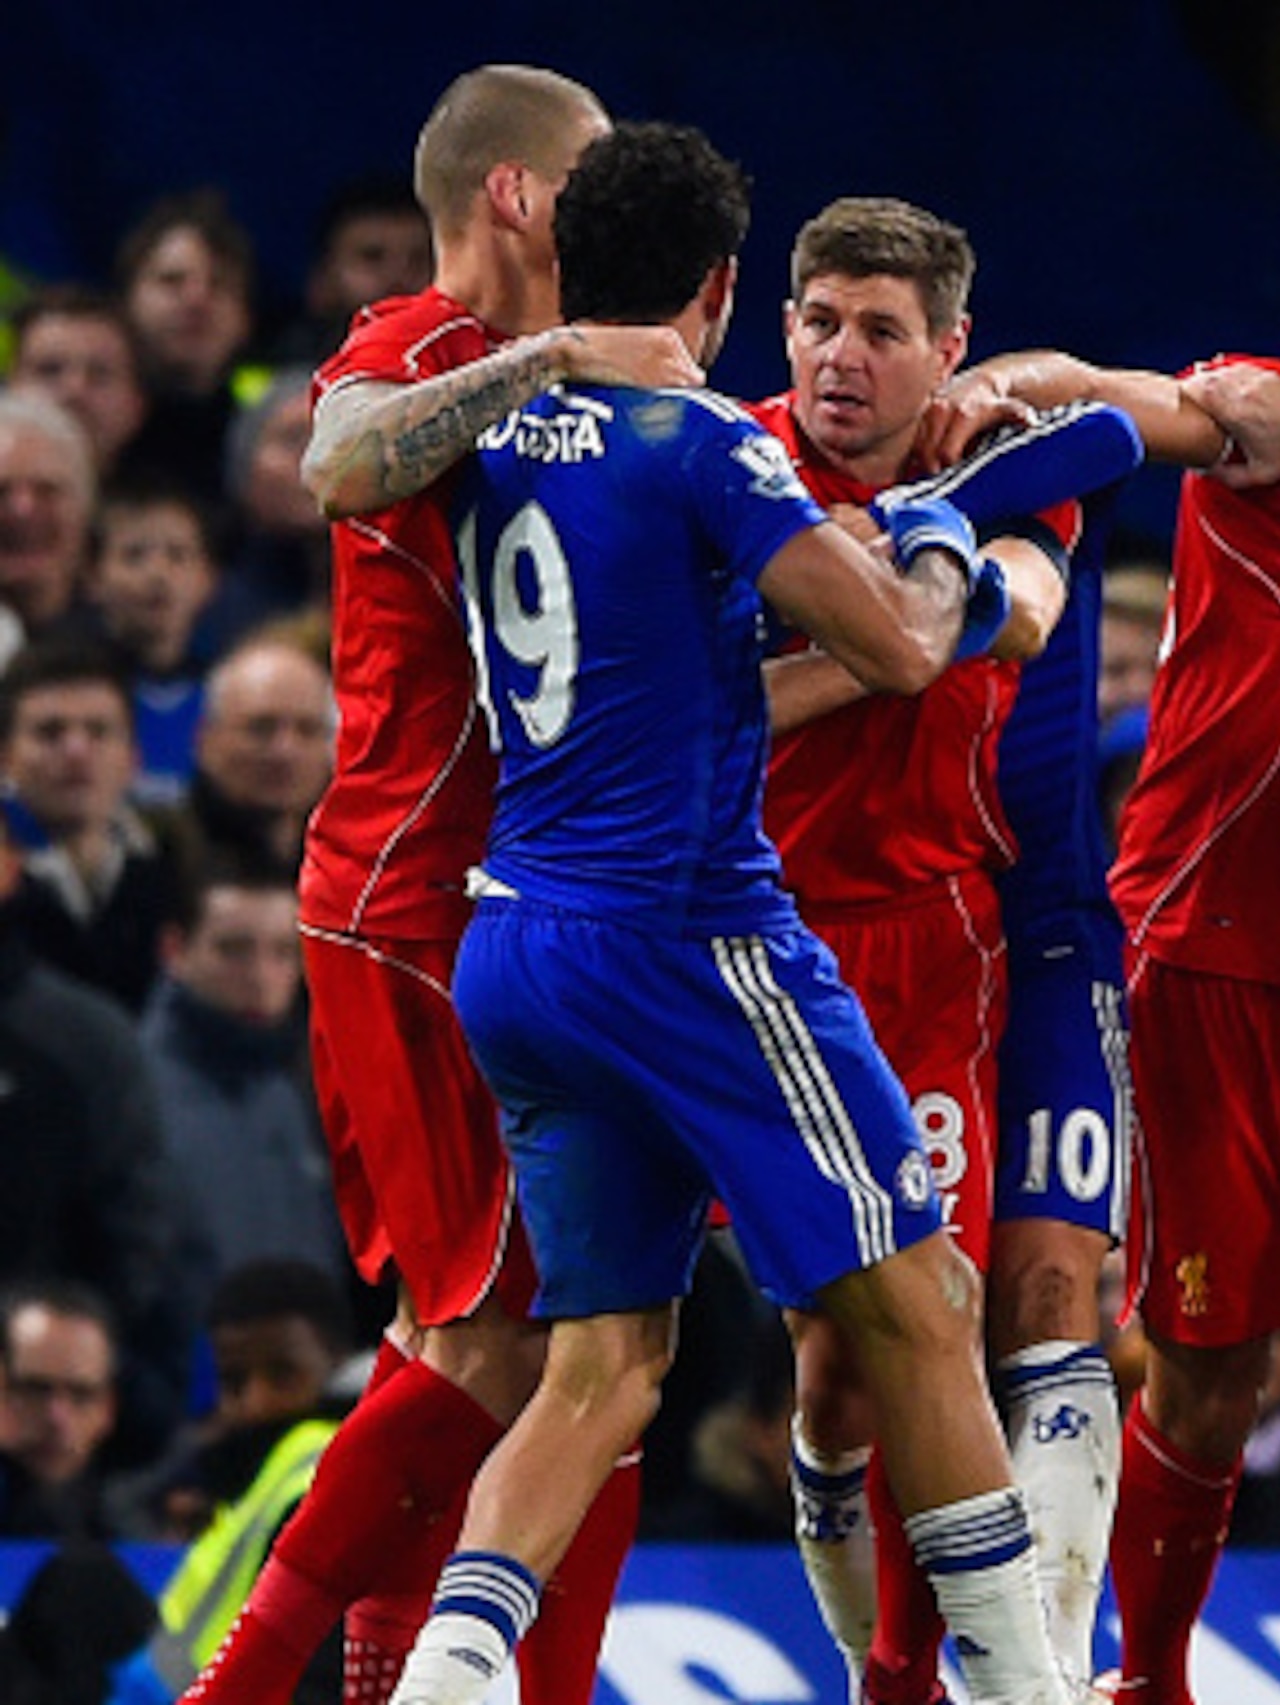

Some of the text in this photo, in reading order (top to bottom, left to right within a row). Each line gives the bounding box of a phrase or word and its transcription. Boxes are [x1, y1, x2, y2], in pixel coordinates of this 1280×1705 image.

[455, 498, 580, 754] 19
[914, 1091, 968, 1190] 8
[1021, 1107, 1111, 1202] 10
